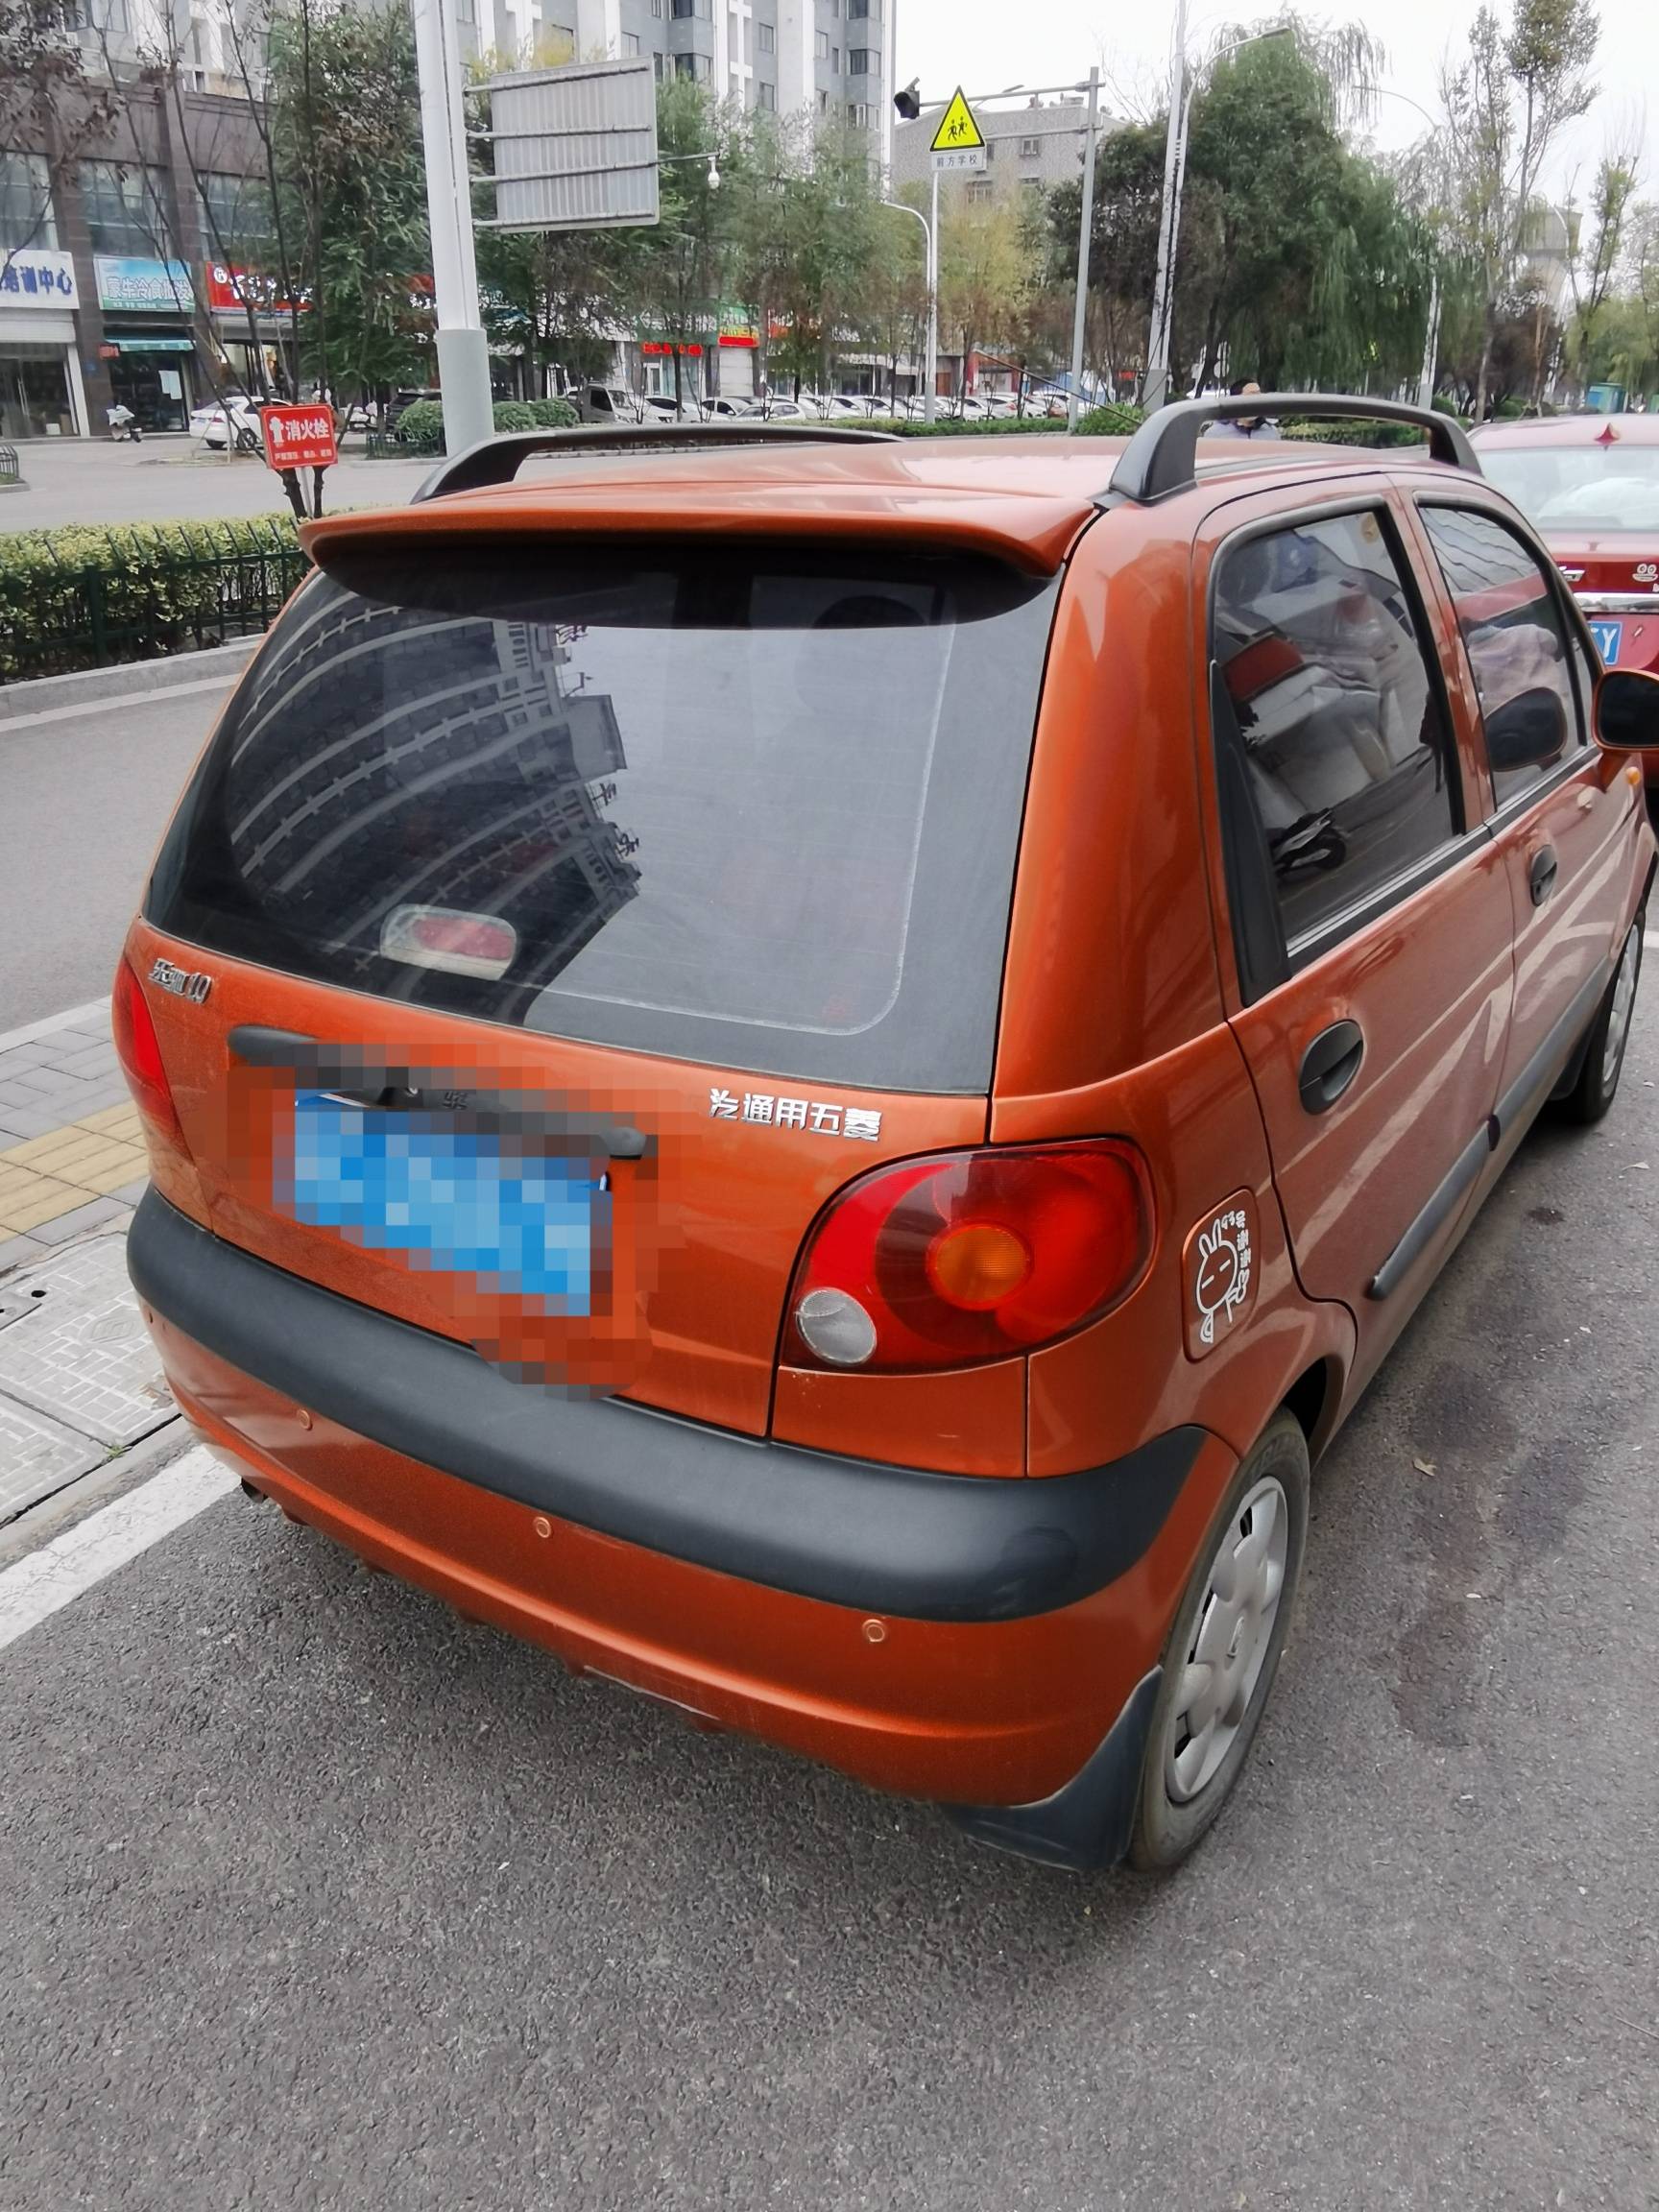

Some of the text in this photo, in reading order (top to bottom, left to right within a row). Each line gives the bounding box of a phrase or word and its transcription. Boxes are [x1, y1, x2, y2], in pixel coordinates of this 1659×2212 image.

[936, 154, 977, 168] 前方学校
[285, 417, 331, 442] 消火栓
